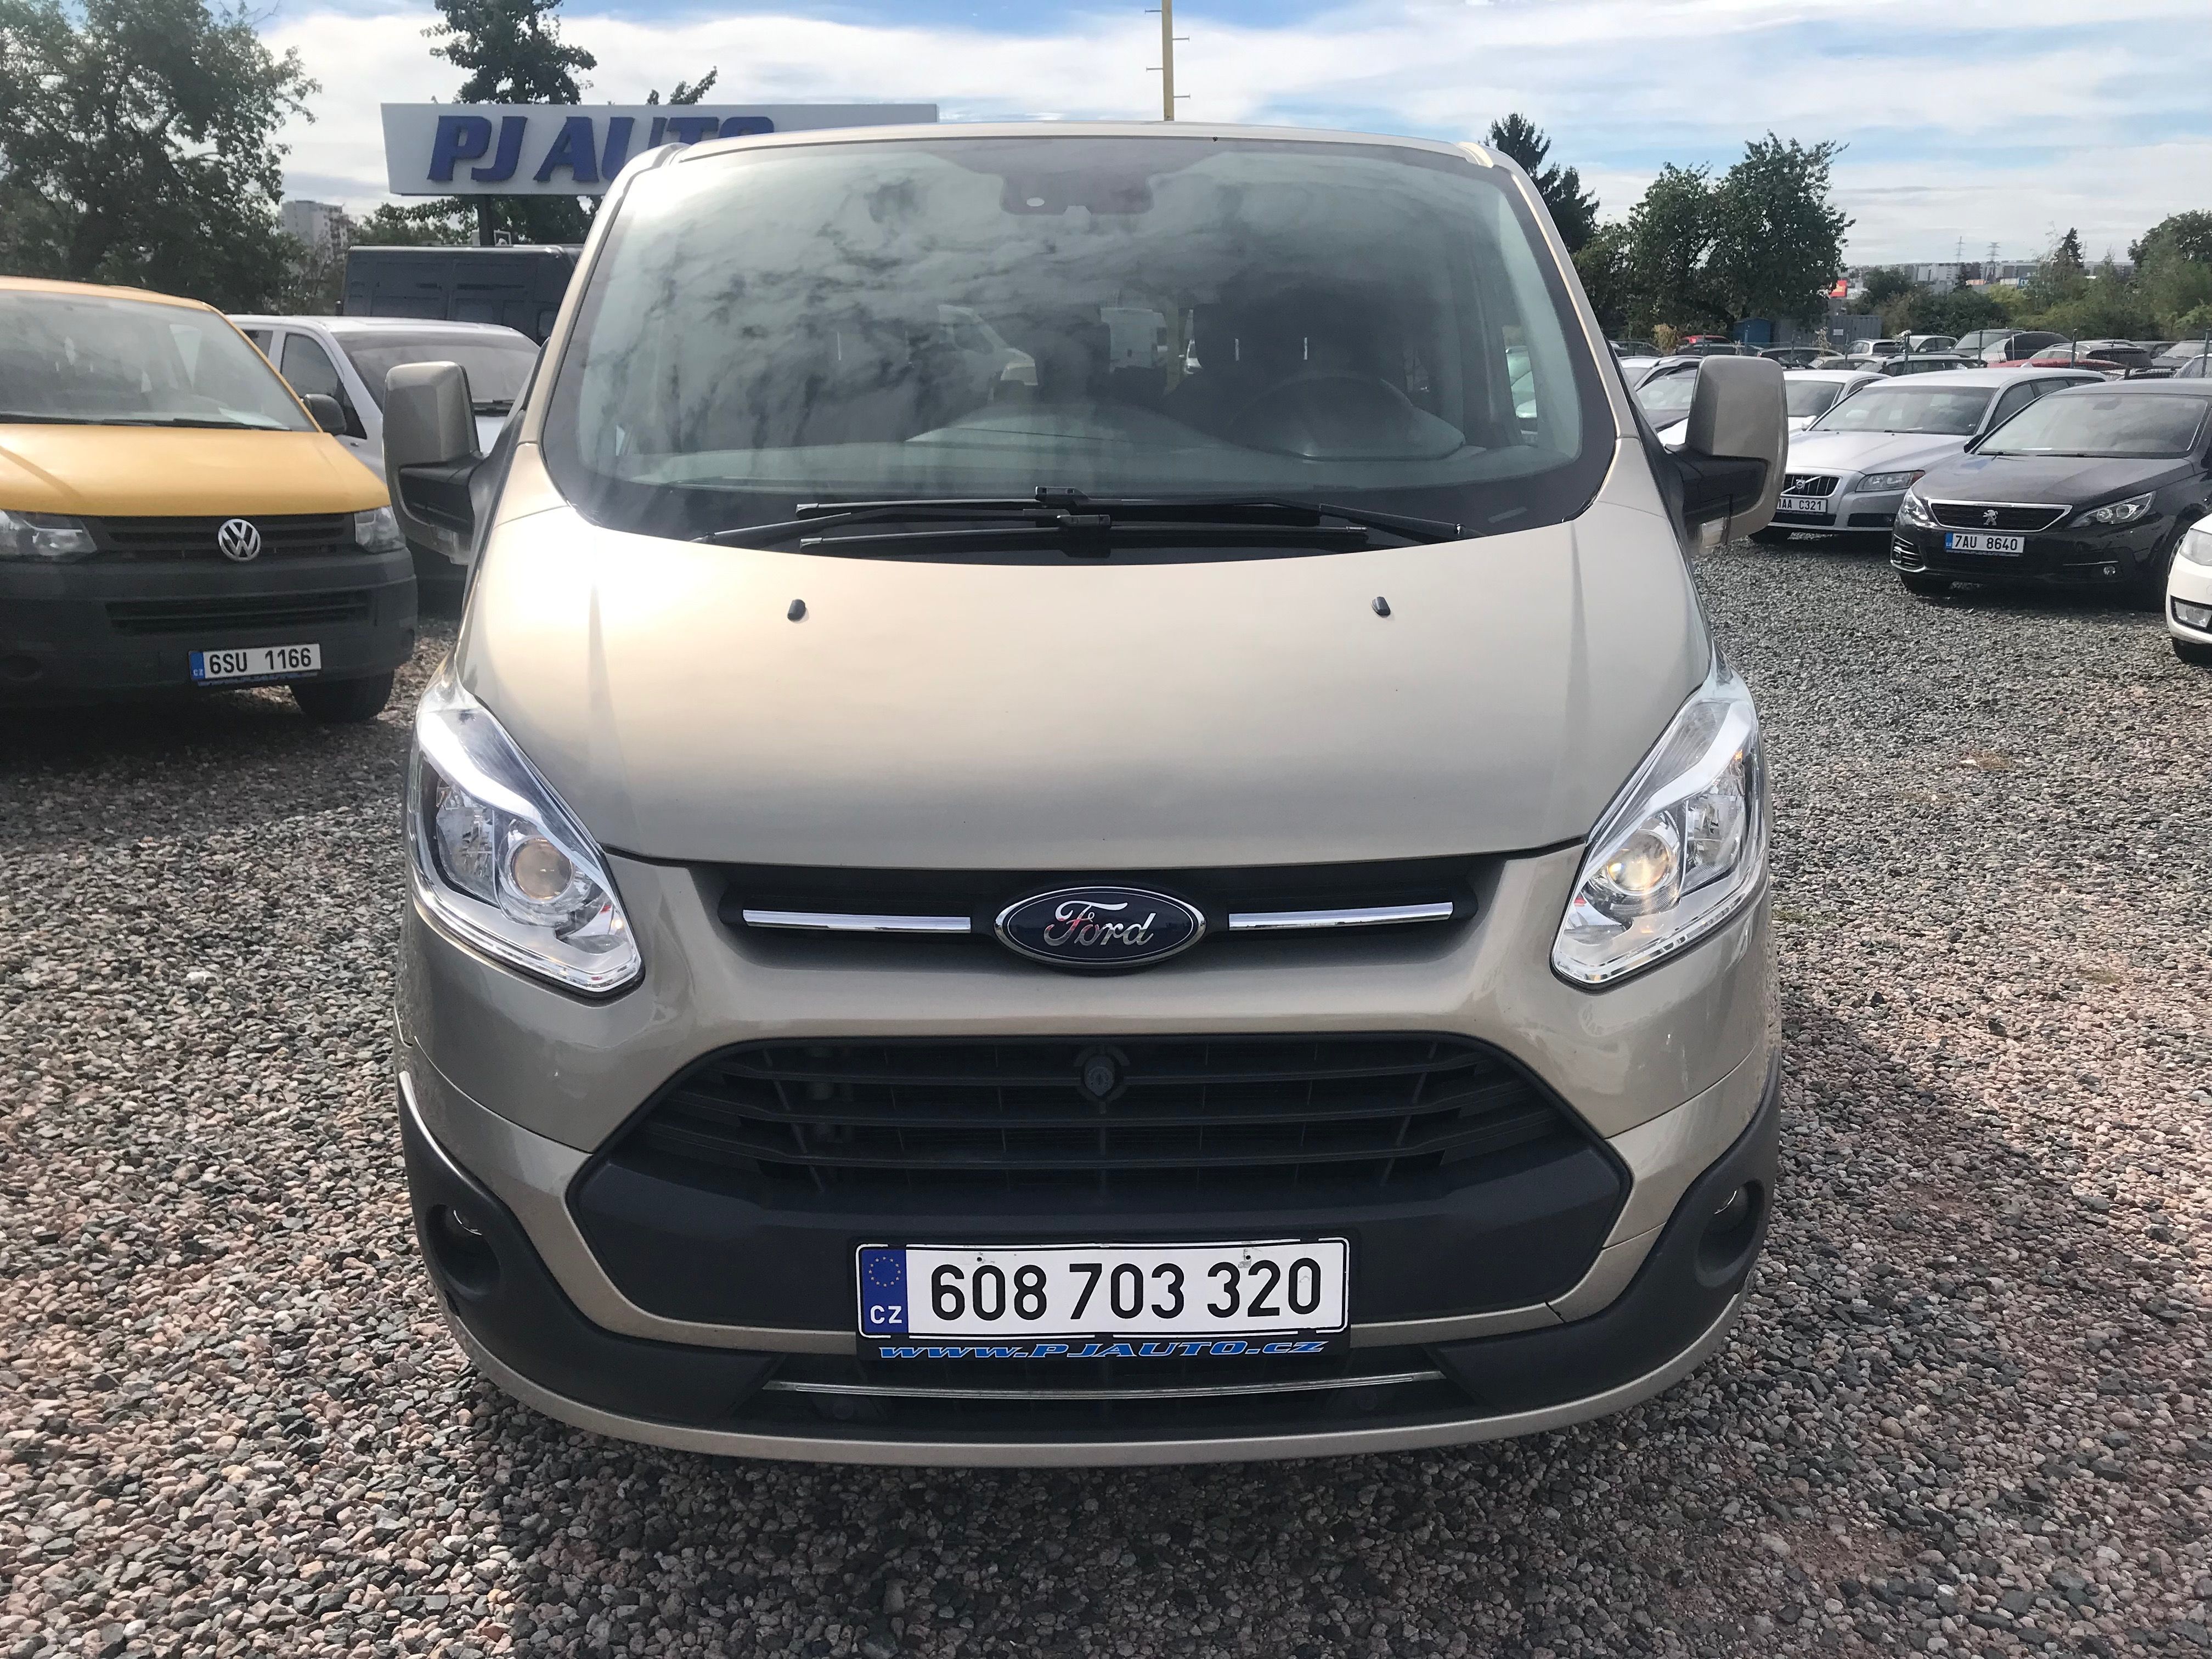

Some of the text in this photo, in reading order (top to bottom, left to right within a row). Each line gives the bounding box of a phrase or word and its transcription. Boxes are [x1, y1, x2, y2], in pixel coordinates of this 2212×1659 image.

[426, 116, 528, 182] PJ
[1799, 500, 1821, 511] C321
[1955, 535, 2018, 551] 7AU 8640
[209, 647, 312, 675] 6SU 1166
[1043, 900, 1156, 946] Ford
[931, 1257, 1321, 1321] 608 703 320
[870, 1305, 902, 1324] CZ
